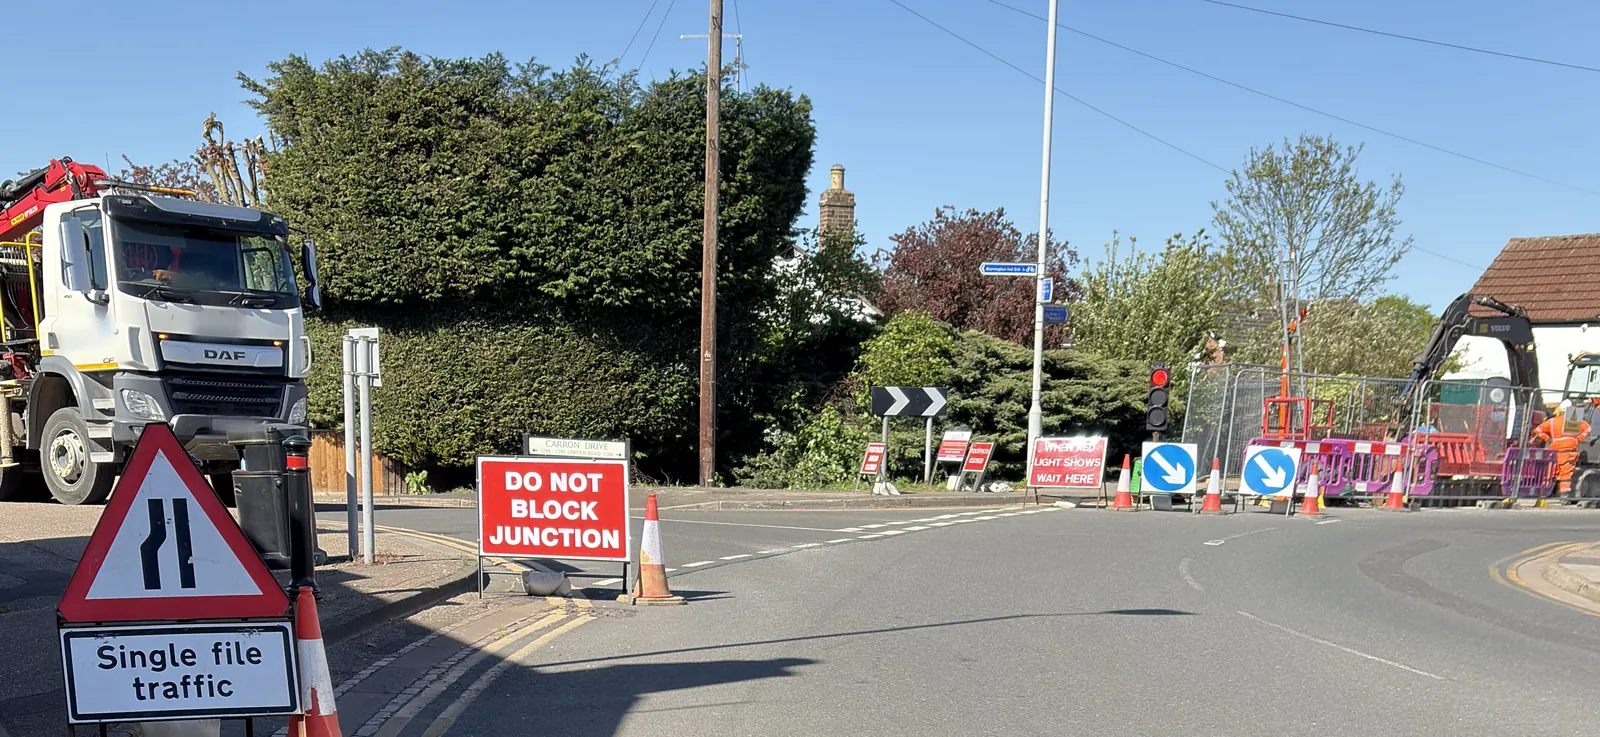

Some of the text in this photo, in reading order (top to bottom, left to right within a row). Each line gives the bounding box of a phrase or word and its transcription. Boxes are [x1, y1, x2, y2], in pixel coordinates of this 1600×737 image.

[204, 350, 246, 360] DAF
[545, 439, 608, 450] CARRON DRIVE
[1034, 458, 1101, 467] LIGHT SHOWS
[505, 471, 603, 493] DO NOT
[1037, 474, 1094, 484] WAIT HERE
[511, 499, 599, 521] BLOCK
[489, 526, 620, 549] JUNCTION
[96, 641, 262, 672] Single file
[133, 674, 234, 701] traffic
